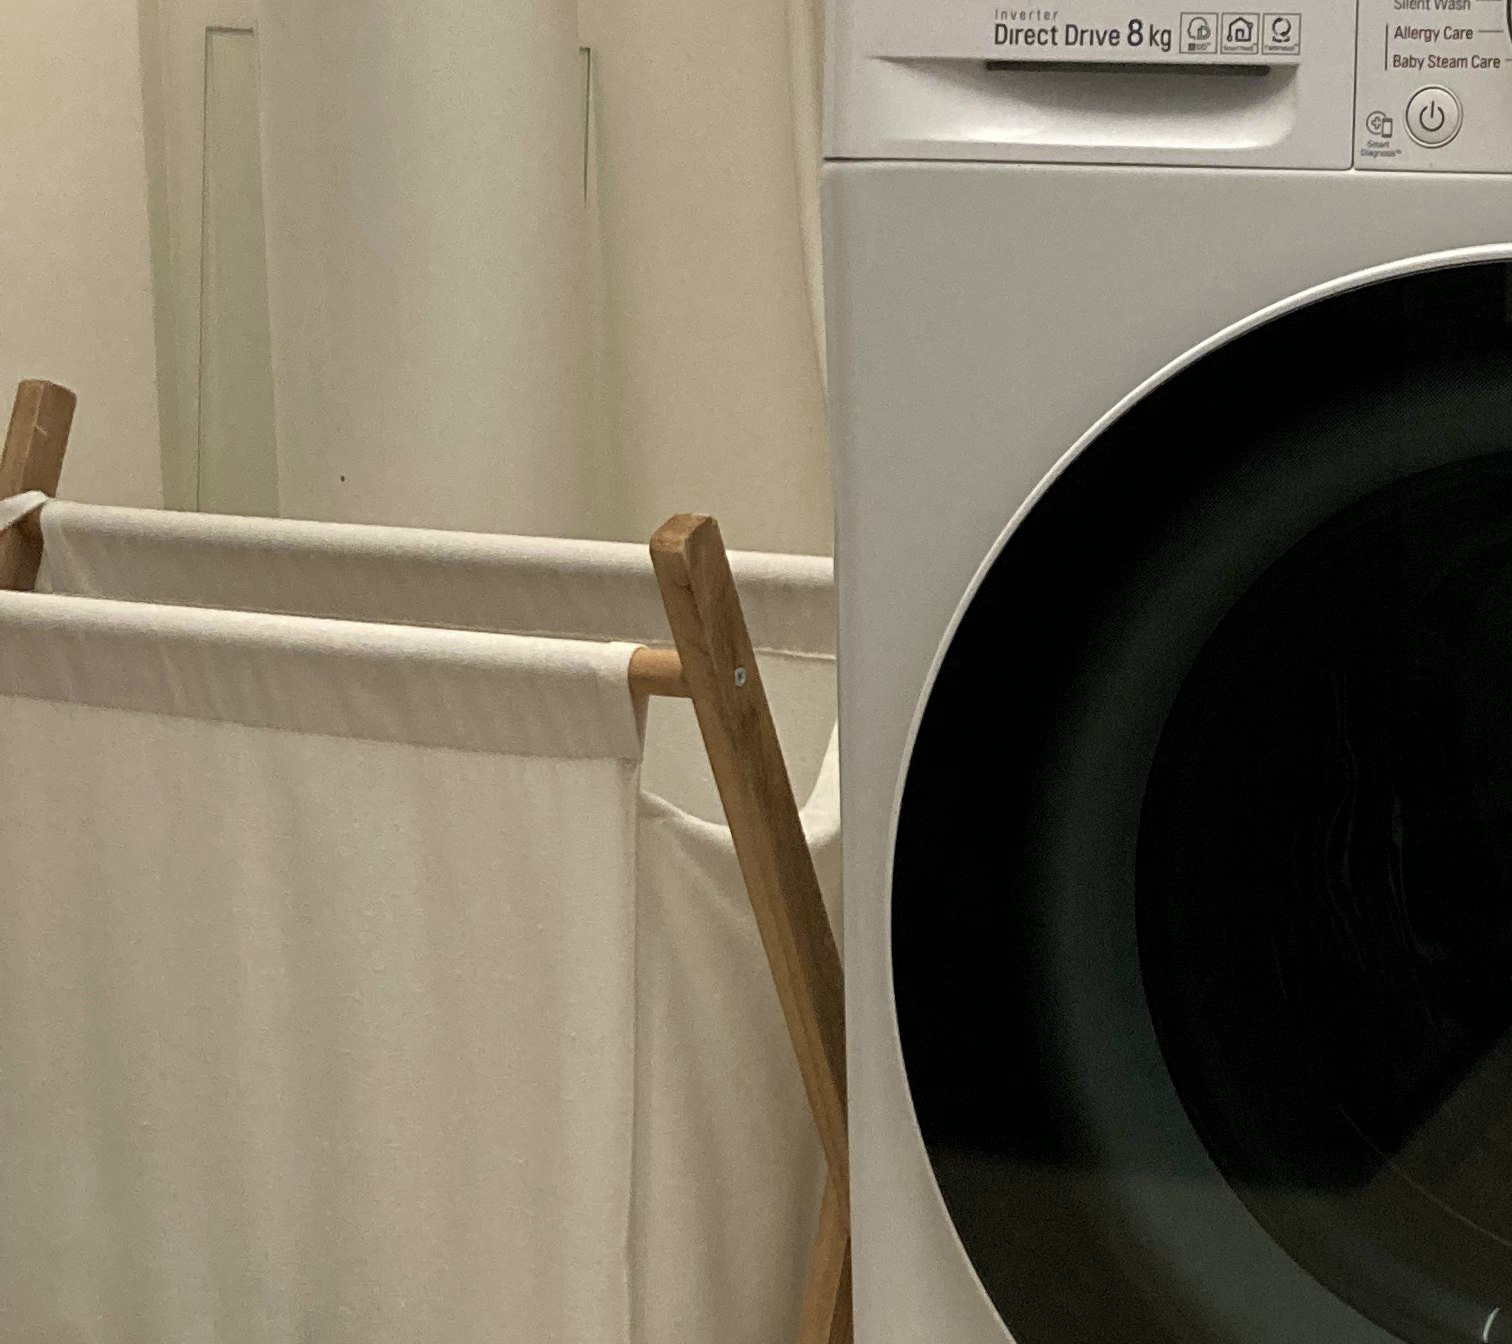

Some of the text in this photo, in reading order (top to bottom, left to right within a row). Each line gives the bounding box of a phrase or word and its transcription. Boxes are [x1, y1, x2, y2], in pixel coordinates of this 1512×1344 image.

[994, 8, 1059, 20] Inverter
[994, 19, 1172, 51] Direct Drive 8 kg
[1394, 26, 1473, 43] Allergy Care
[1393, 55, 1500, 71] Baby Steam Care
[1367, 140, 1389, 148] Smart
